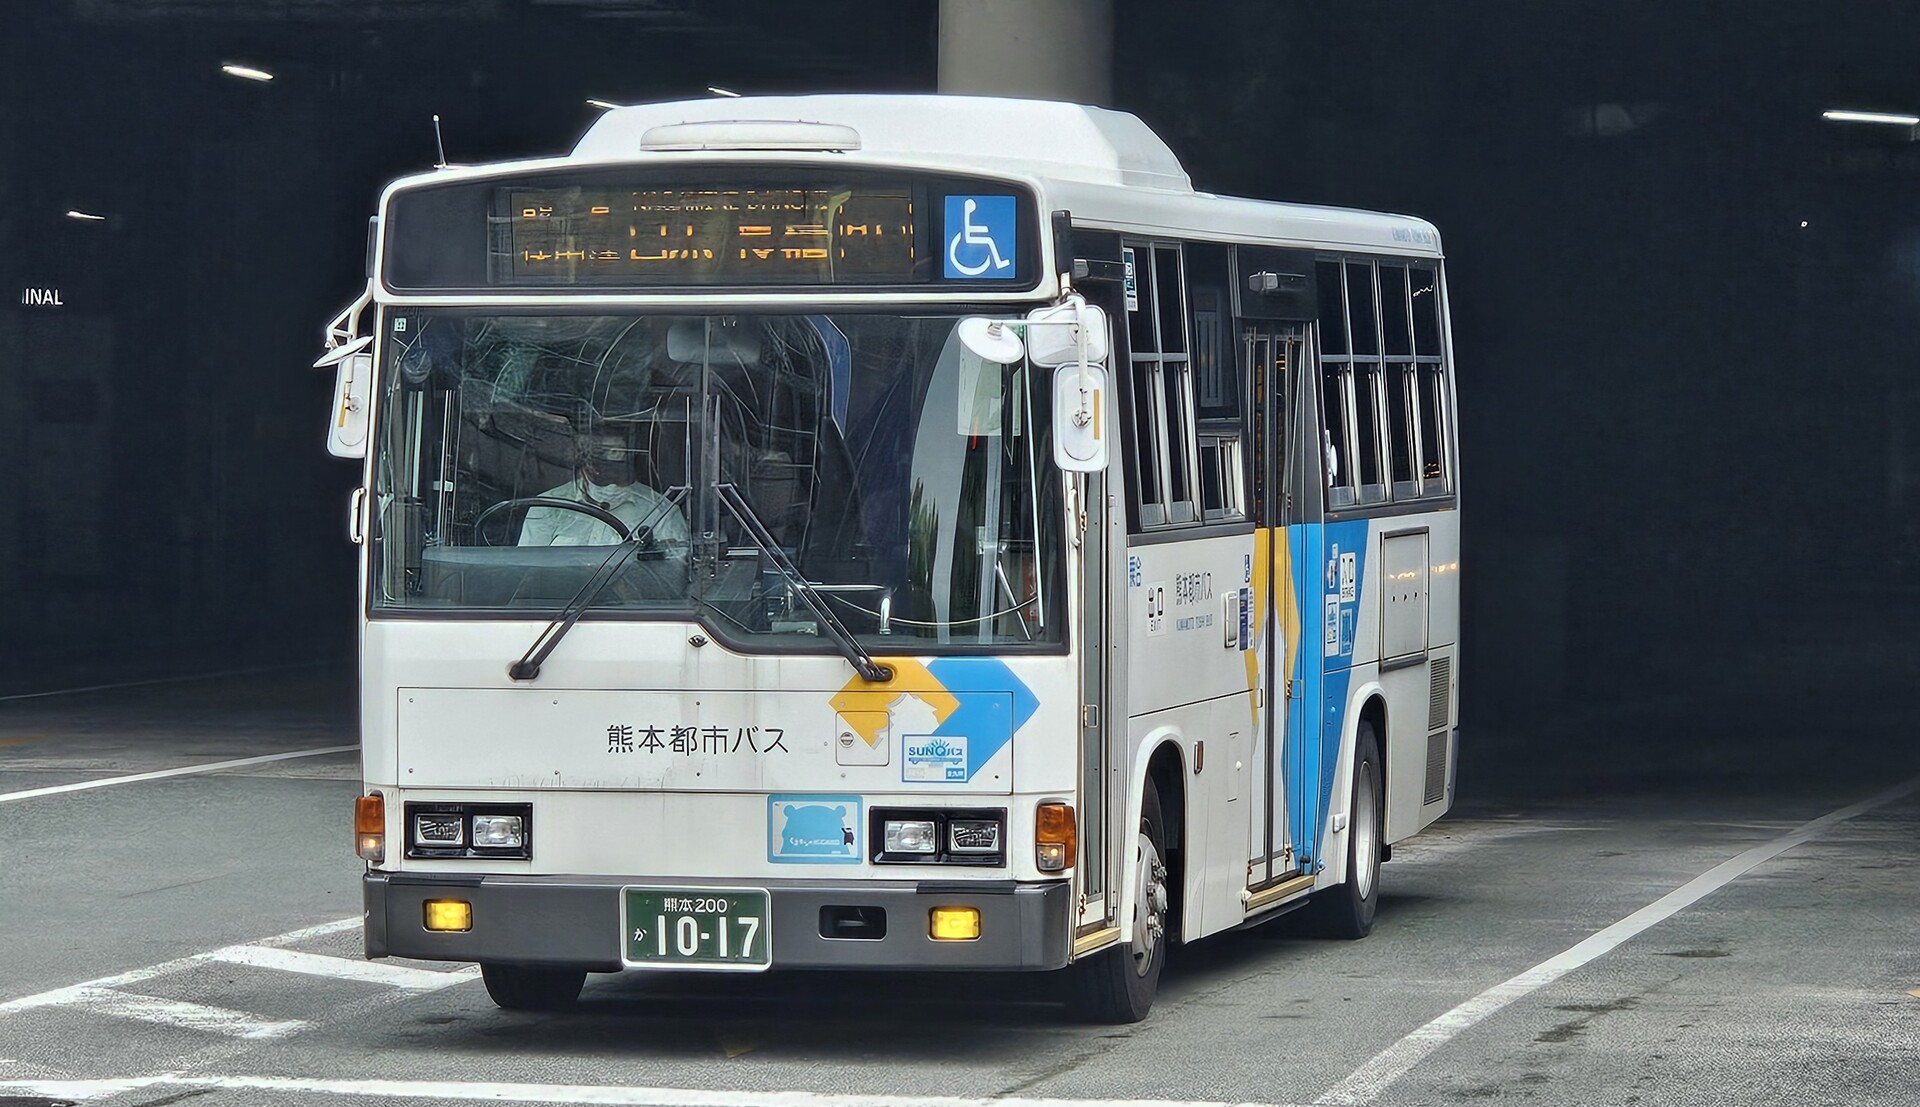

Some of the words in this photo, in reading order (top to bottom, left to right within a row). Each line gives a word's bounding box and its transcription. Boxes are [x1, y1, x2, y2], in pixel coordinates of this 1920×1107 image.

[22, 288, 63, 305] INAL
[606, 724, 789, 756] 熊本都市バス
[633, 928, 647, 942] か
[657, 915, 759, 958] 10-17
